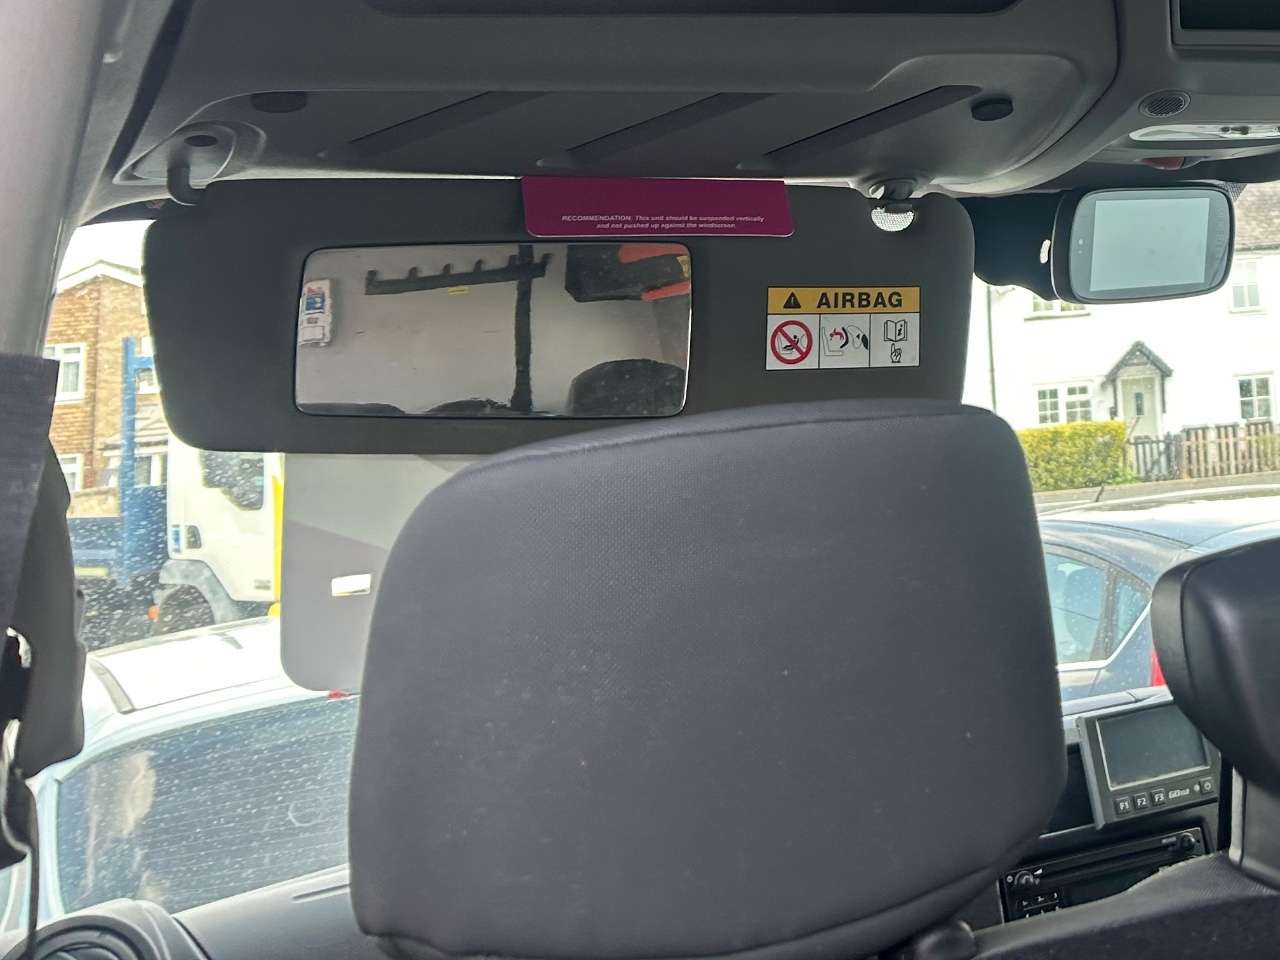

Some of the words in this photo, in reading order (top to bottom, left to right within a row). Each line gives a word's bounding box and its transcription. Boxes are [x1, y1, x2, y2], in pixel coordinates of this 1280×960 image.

[816, 291, 903, 309] AIRBAG
[1137, 797, 1146, 806] F2
[1154, 793, 1164, 802] F3
[1119, 801, 1129, 810] F1
